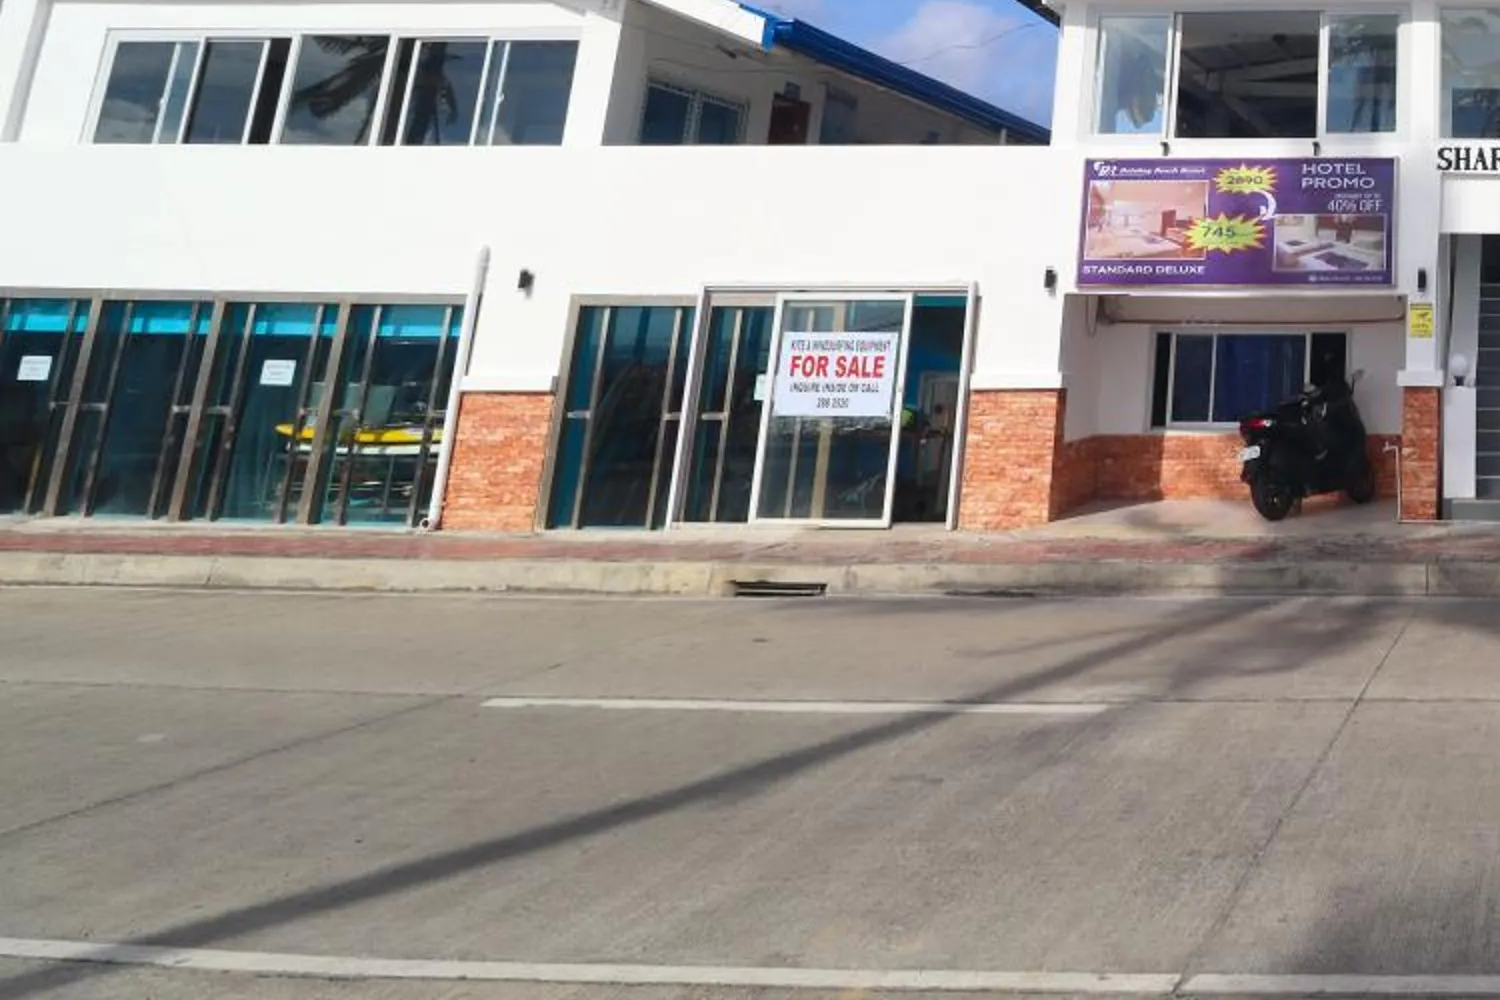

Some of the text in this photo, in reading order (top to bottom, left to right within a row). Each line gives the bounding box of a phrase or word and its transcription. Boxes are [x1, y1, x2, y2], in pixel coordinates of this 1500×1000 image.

[1301, 163, 1367, 175] HOTEL
[1301, 177, 1375, 189] PROMO
[1082, 265, 1206, 275] STANDARD DELUXE
[789, 354, 885, 378] FOR SALE
